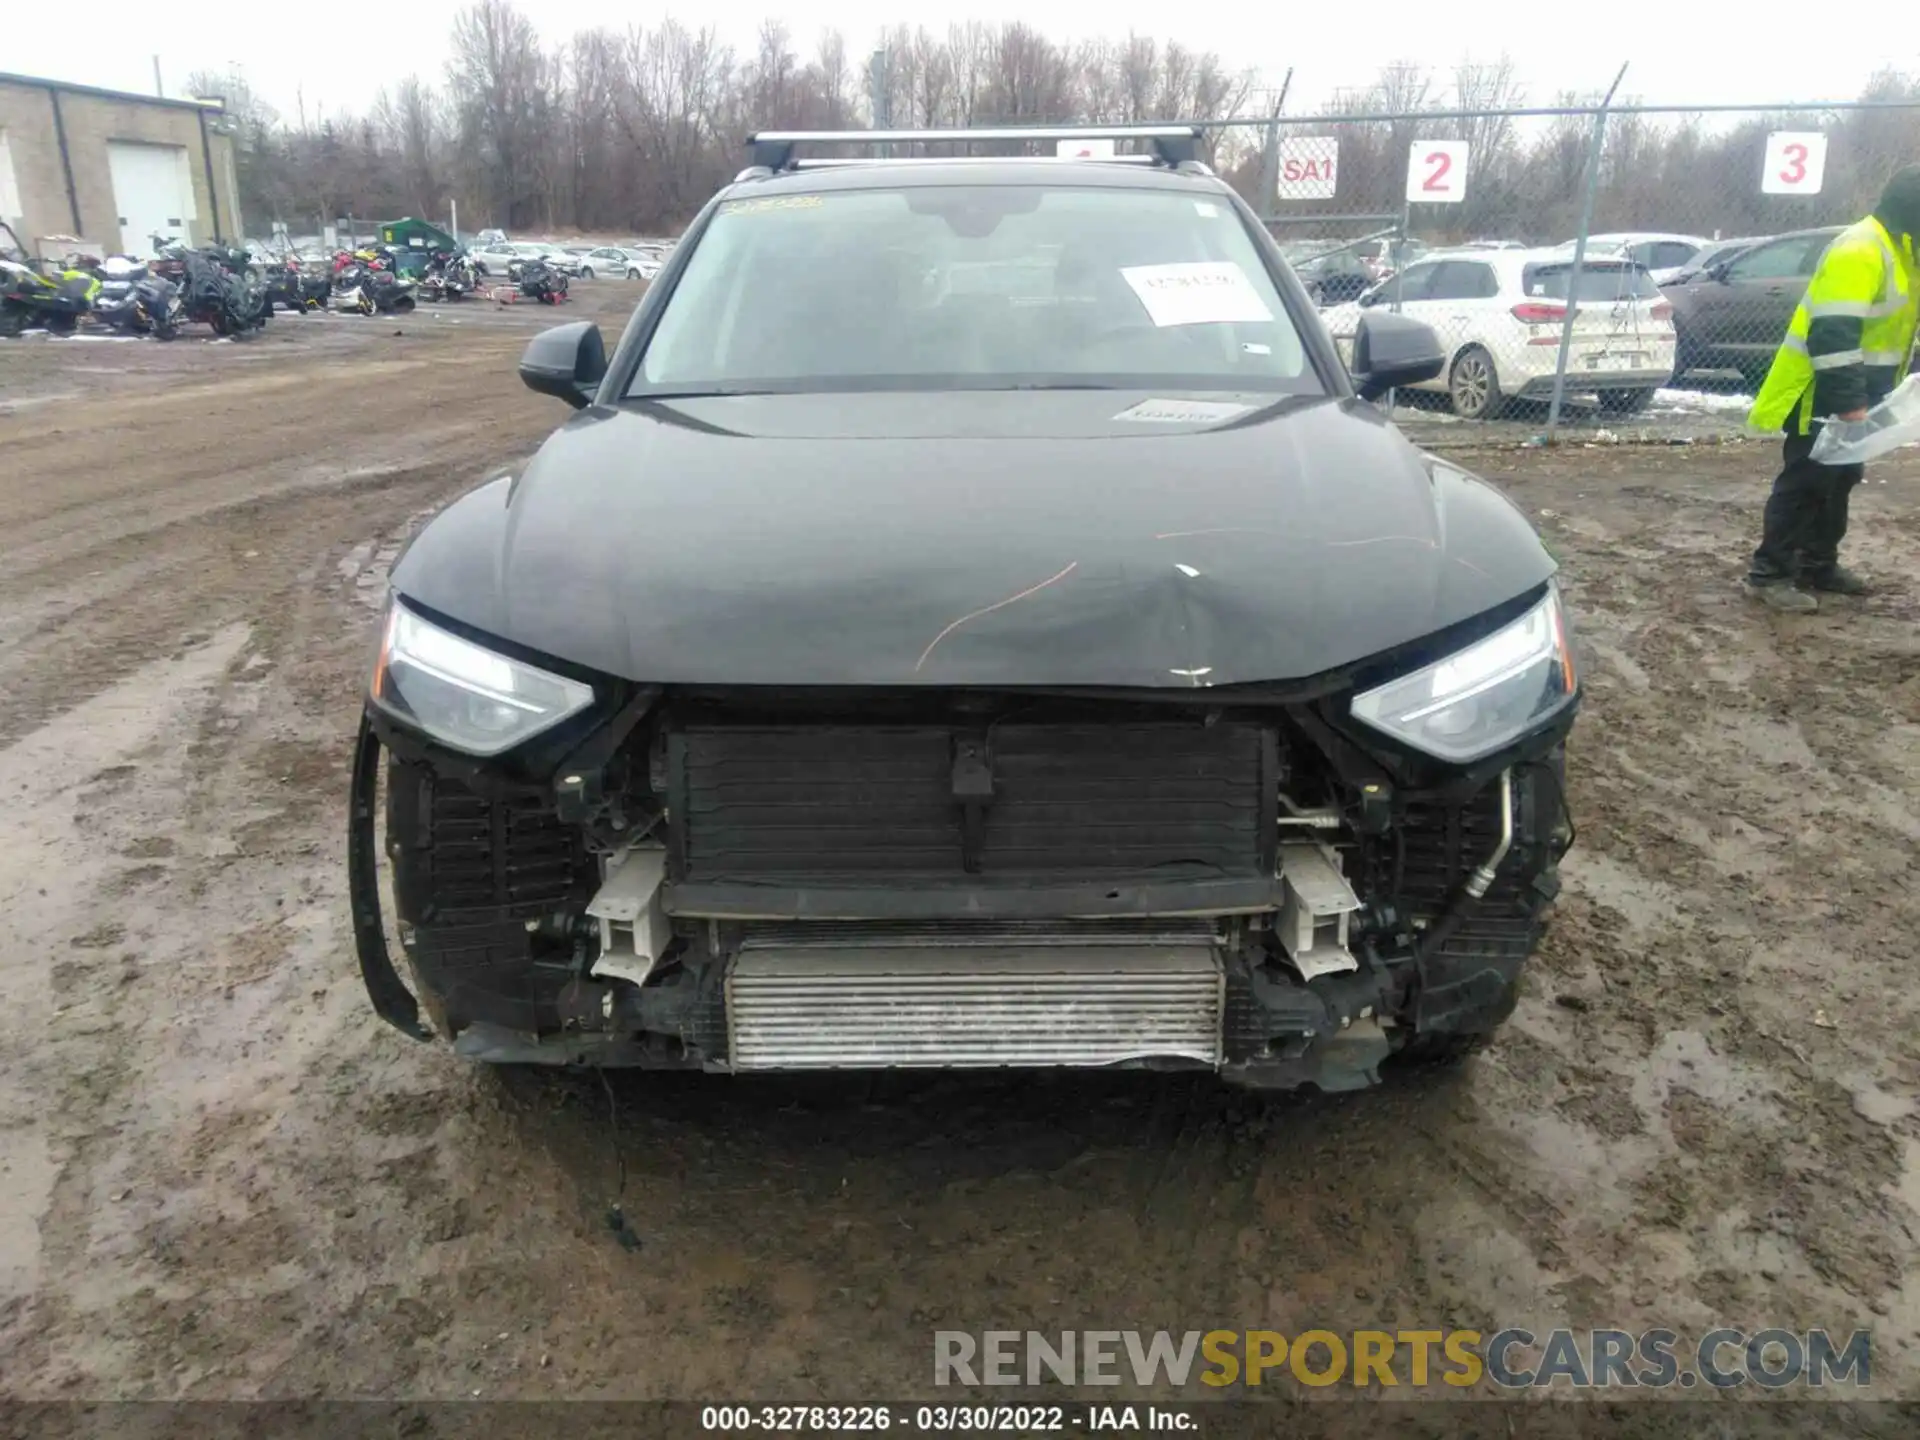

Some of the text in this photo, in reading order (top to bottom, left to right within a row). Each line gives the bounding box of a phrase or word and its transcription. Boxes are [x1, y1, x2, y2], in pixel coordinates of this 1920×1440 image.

[1284, 157, 1332, 181] SA1
[1422, 151, 1452, 191] 2
[1780, 143, 1808, 184] 3
